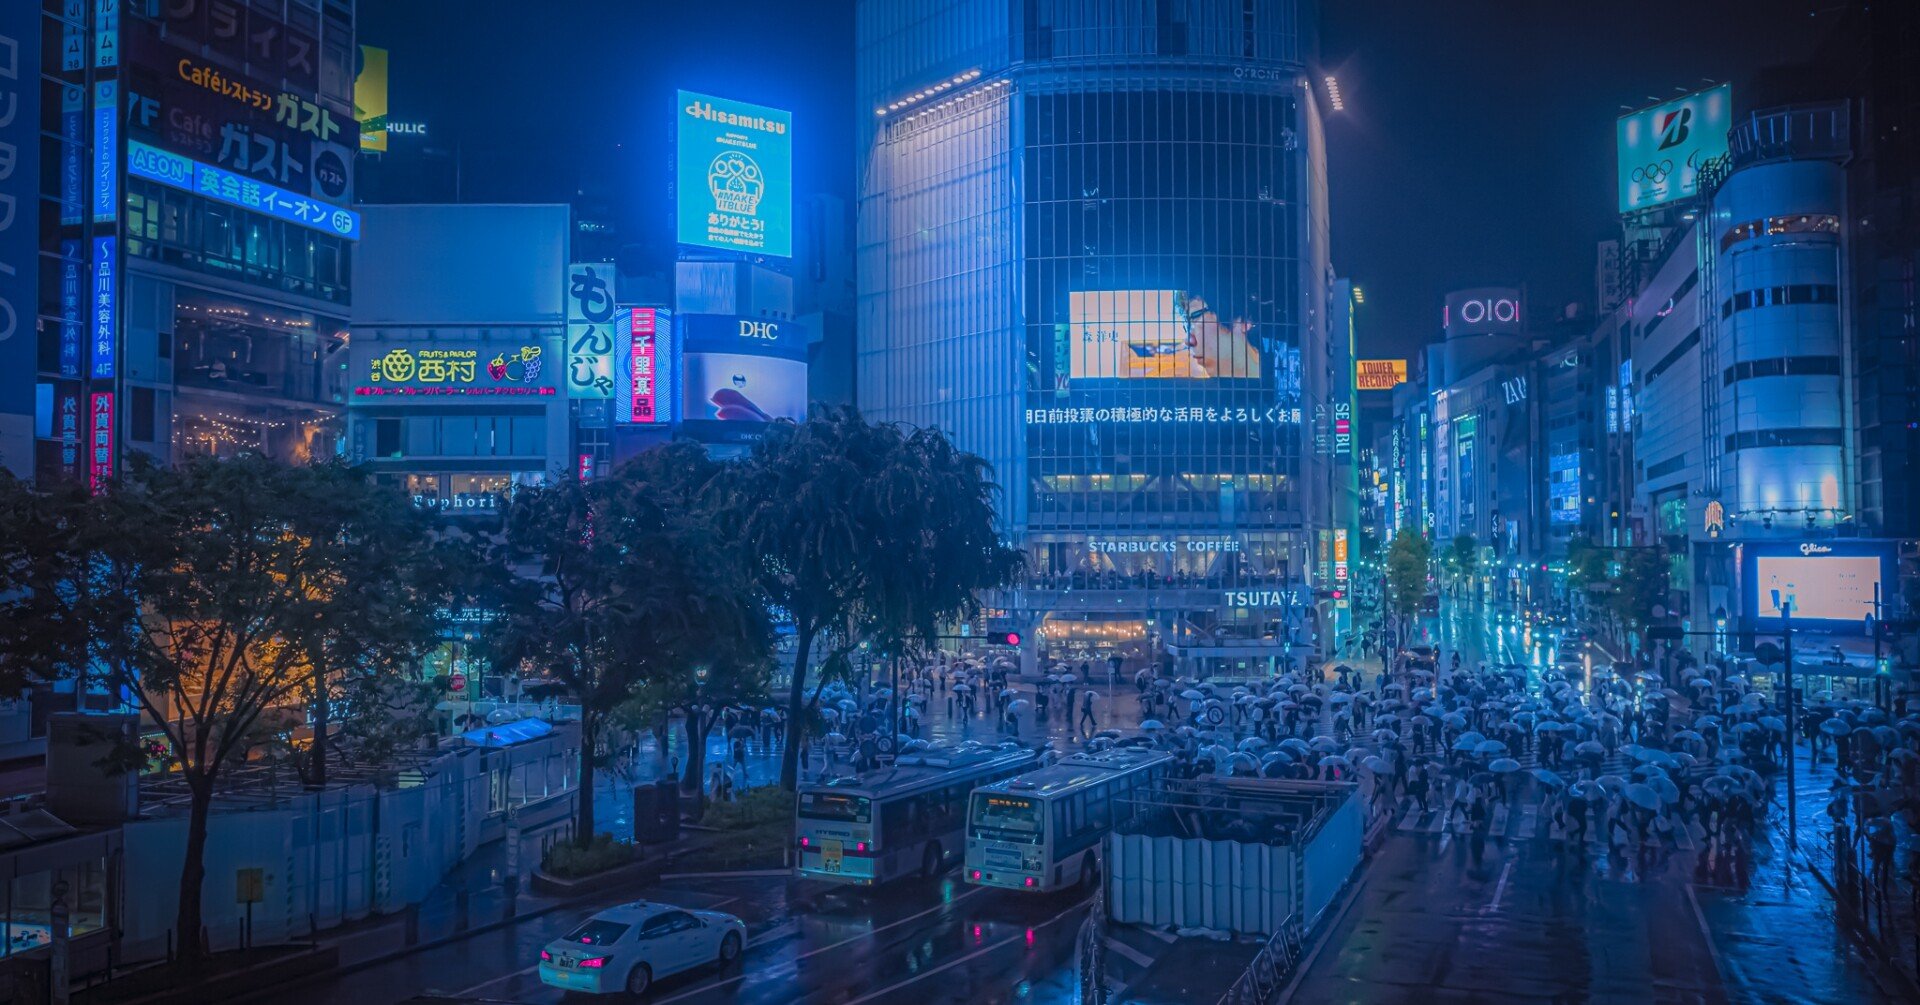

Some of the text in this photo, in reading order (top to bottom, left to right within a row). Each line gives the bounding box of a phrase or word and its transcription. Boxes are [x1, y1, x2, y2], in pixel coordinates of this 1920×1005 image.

[276, 92, 340, 142] ガスト
[386, 122, 426, 134] HULIC
[685, 101, 787, 135] Hisamitsu
[133, 148, 184, 179] AEON
[217, 122, 304, 184] ガスト
[200, 167, 351, 231] 英会話イーオン 6F
[717, 192, 756, 205] #MAKE
[718, 199, 754, 213] ITBLUE
[97, 262, 111, 356] 品川美容外科
[570, 265, 614, 396] もんじゃ
[739, 321, 778, 340] DHC
[96, 363, 112, 376] 4F
[418, 360, 477, 382] 西村
[633, 313, 652, 416] 三千里薬品
[1361, 362, 1394, 374] TOWER
[1358, 375, 1400, 388] RECORDS
[95, 395, 110, 464] 外貨両替
[1335, 403, 1350, 454] SEIBU
[1089, 541, 1240, 553] STARBUCKS COFFEE
[1800, 543, 1832, 556] Glico
[815, 829, 850, 837] HYBRID
